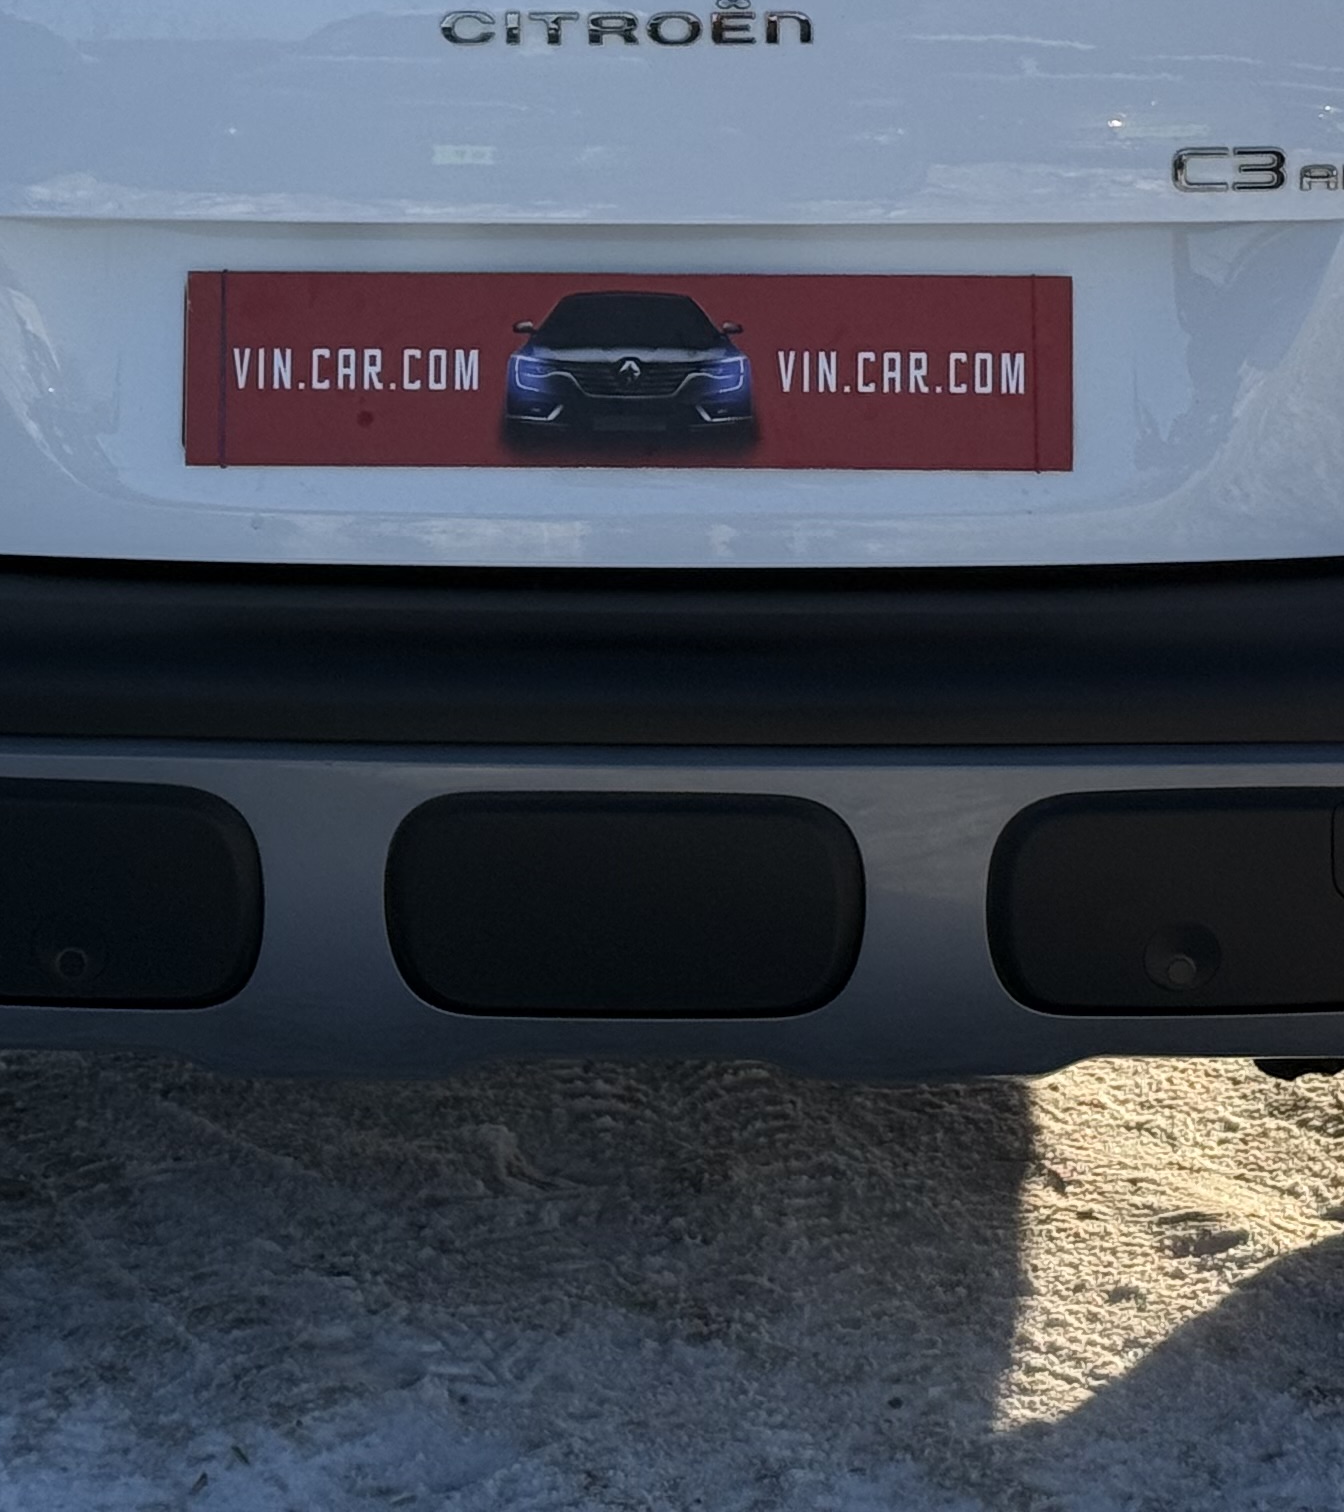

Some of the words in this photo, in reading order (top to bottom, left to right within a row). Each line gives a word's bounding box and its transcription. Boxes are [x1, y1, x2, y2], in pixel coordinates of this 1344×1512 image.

[1171, 146, 1287, 192] C3
[232, 347, 480, 391] VIN.CAR.COM
[777, 350, 1025, 395] VIN.CAR.COM
